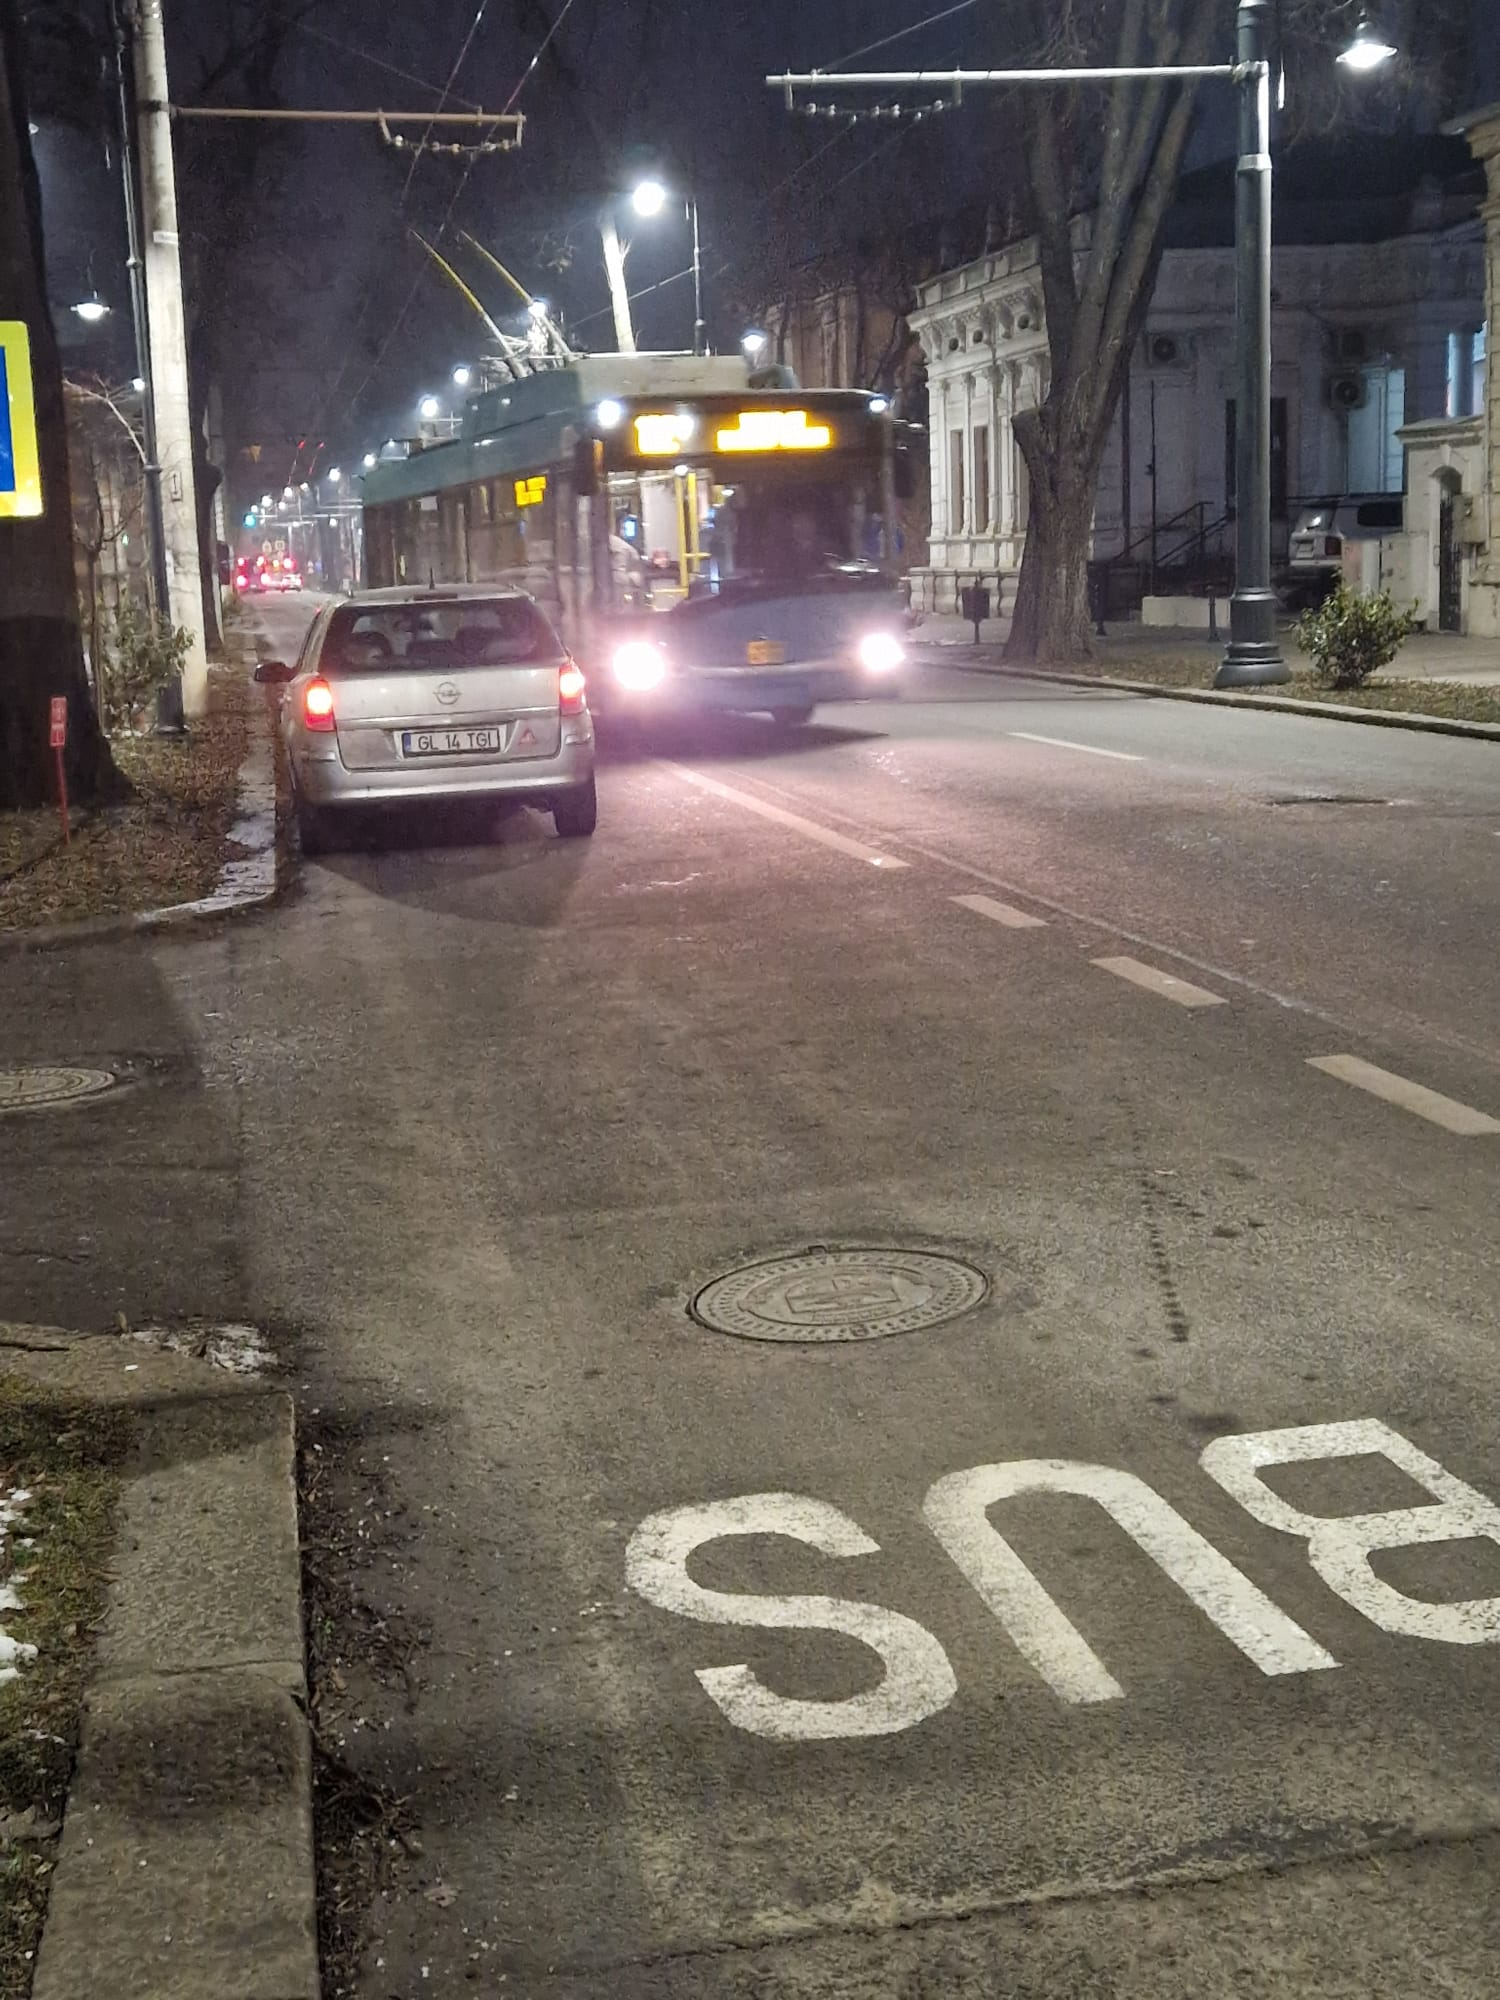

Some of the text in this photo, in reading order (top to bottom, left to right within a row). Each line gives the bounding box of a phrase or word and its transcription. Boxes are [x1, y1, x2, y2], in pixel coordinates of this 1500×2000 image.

[417, 731, 492, 751] GL 14 TGI
[625, 1417, 1500, 1741] BUS
